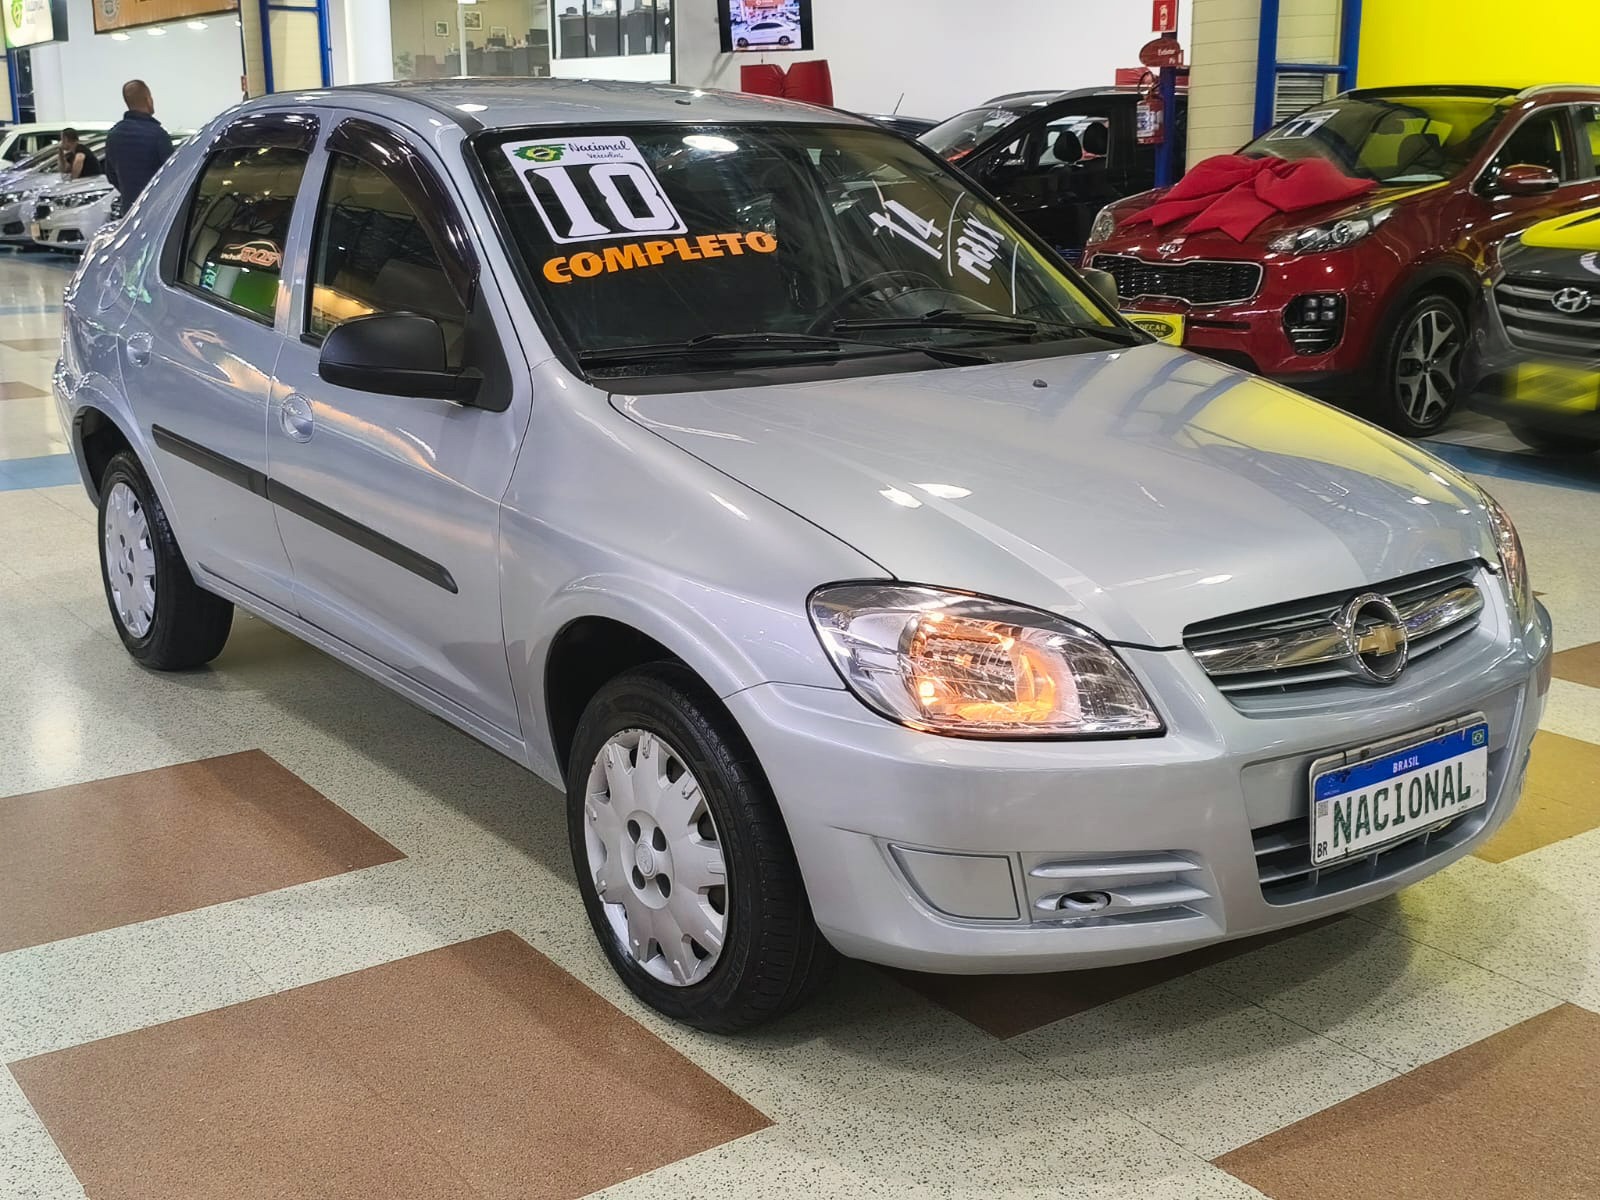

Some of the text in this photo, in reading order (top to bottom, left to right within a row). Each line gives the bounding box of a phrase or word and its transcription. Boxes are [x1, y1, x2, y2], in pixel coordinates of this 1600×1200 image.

[568, 140, 631, 153] Nacional
[532, 163, 675, 237] 10
[542, 231, 778, 285] COMPLETO
[1392, 754, 1420, 774] BRASIL
[1333, 762, 1471, 848] NACIONAL
[1317, 841, 1328, 858] BR
